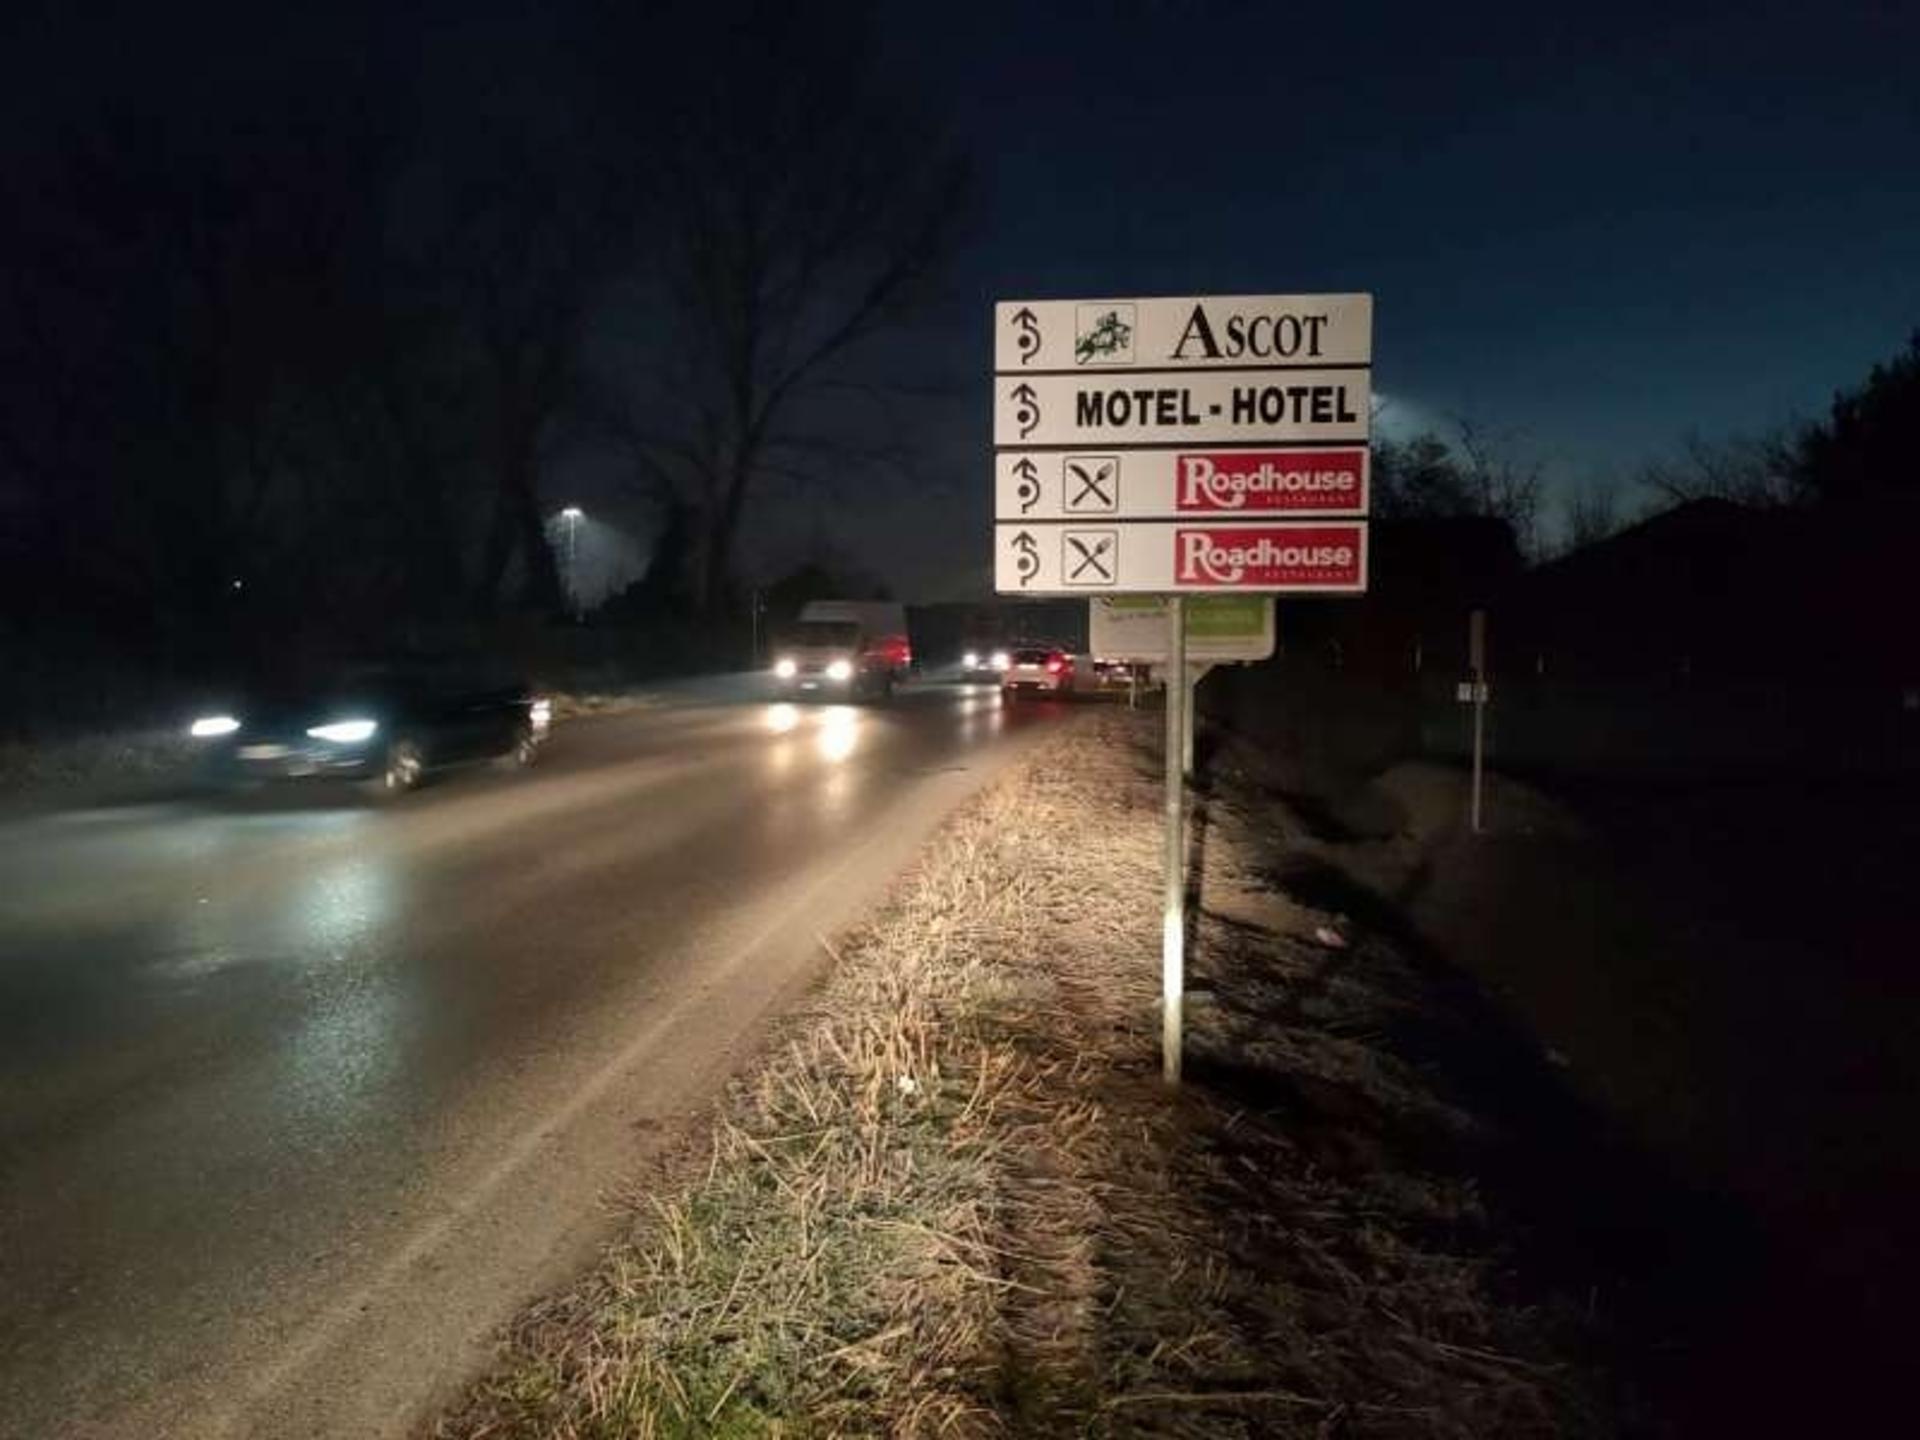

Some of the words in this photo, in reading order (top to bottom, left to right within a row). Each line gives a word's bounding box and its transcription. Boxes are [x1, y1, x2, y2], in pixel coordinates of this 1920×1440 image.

[1171, 303, 1328, 358] ASCOT
[1076, 389, 1200, 427] MOTEL
[1209, 404, 1221, 415] -
[1232, 386, 1356, 424] HOTEL
[1181, 457, 1355, 507] Roadhouse
[1180, 532, 1352, 582] Roadhouse
